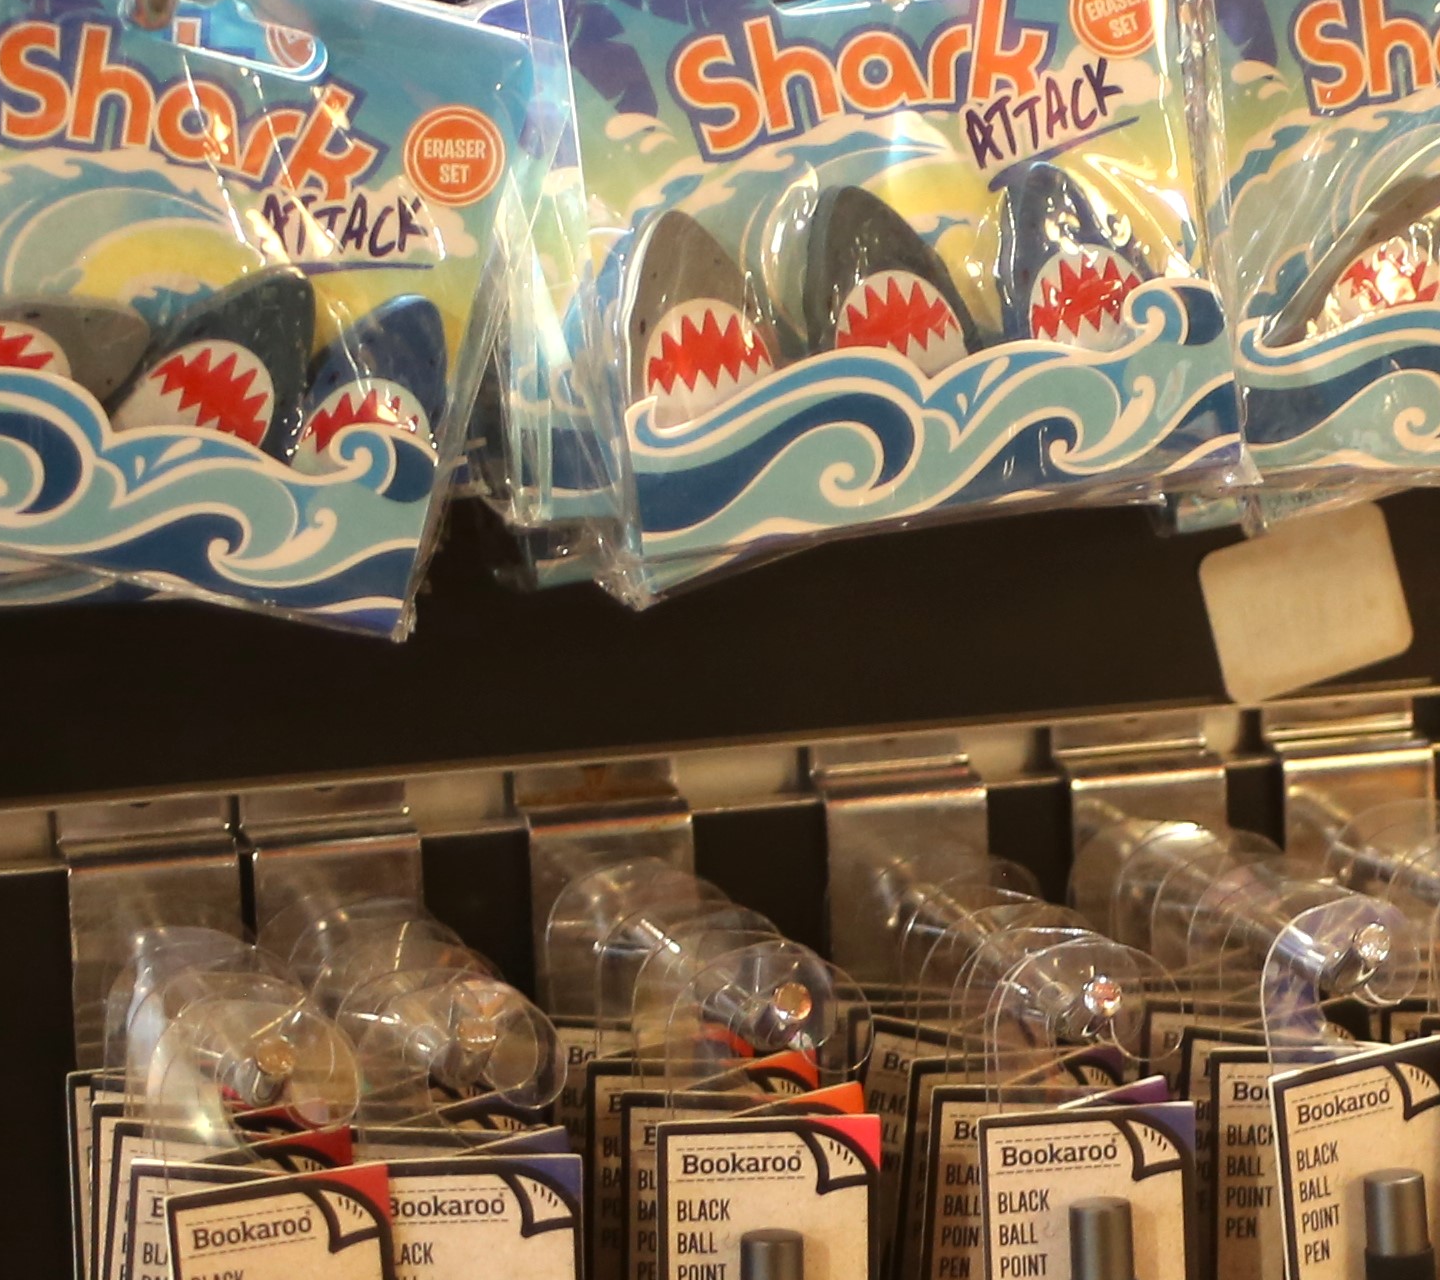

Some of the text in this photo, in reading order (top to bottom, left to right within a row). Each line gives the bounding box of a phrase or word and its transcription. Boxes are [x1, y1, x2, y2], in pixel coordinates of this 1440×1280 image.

[1109, 14, 1140, 40] SET
[963, 57, 1124, 168] ATTACK
[422, 134, 488, 163] ERASER
[437, 162, 471, 187] SET
[259, 188, 428, 263] ATTACK
[1296, 1086, 1392, 1126] Bookaroo
[681, 1150, 803, 1176] Bookaroo
[1000, 1140, 1118, 1168] Bookaroo
[1226, 1155, 1265, 1178] BALL
[1295, 1140, 1340, 1172] BLACK
[997, 1189, 1050, 1214] BLACK
[1226, 1186, 1274, 1208] POINT
[1298, 1175, 1333, 1204] BALL
[388, 1192, 507, 1219] Bookaroo
[676, 1198, 731, 1223] BLACK
[191, 1213, 312, 1251] Bookaroo
[1225, 1217, 1258, 1239] PEN
[1301, 1204, 1342, 1235] POINT
[677, 1231, 718, 1255] BALL
[941, 1225, 979, 1248] POIN
[998, 1223, 1038, 1247] BALL
[1304, 1238, 1331, 1266] PEN
[939, 1256, 970, 1279] PEN
[999, 1254, 1049, 1279] POINT
